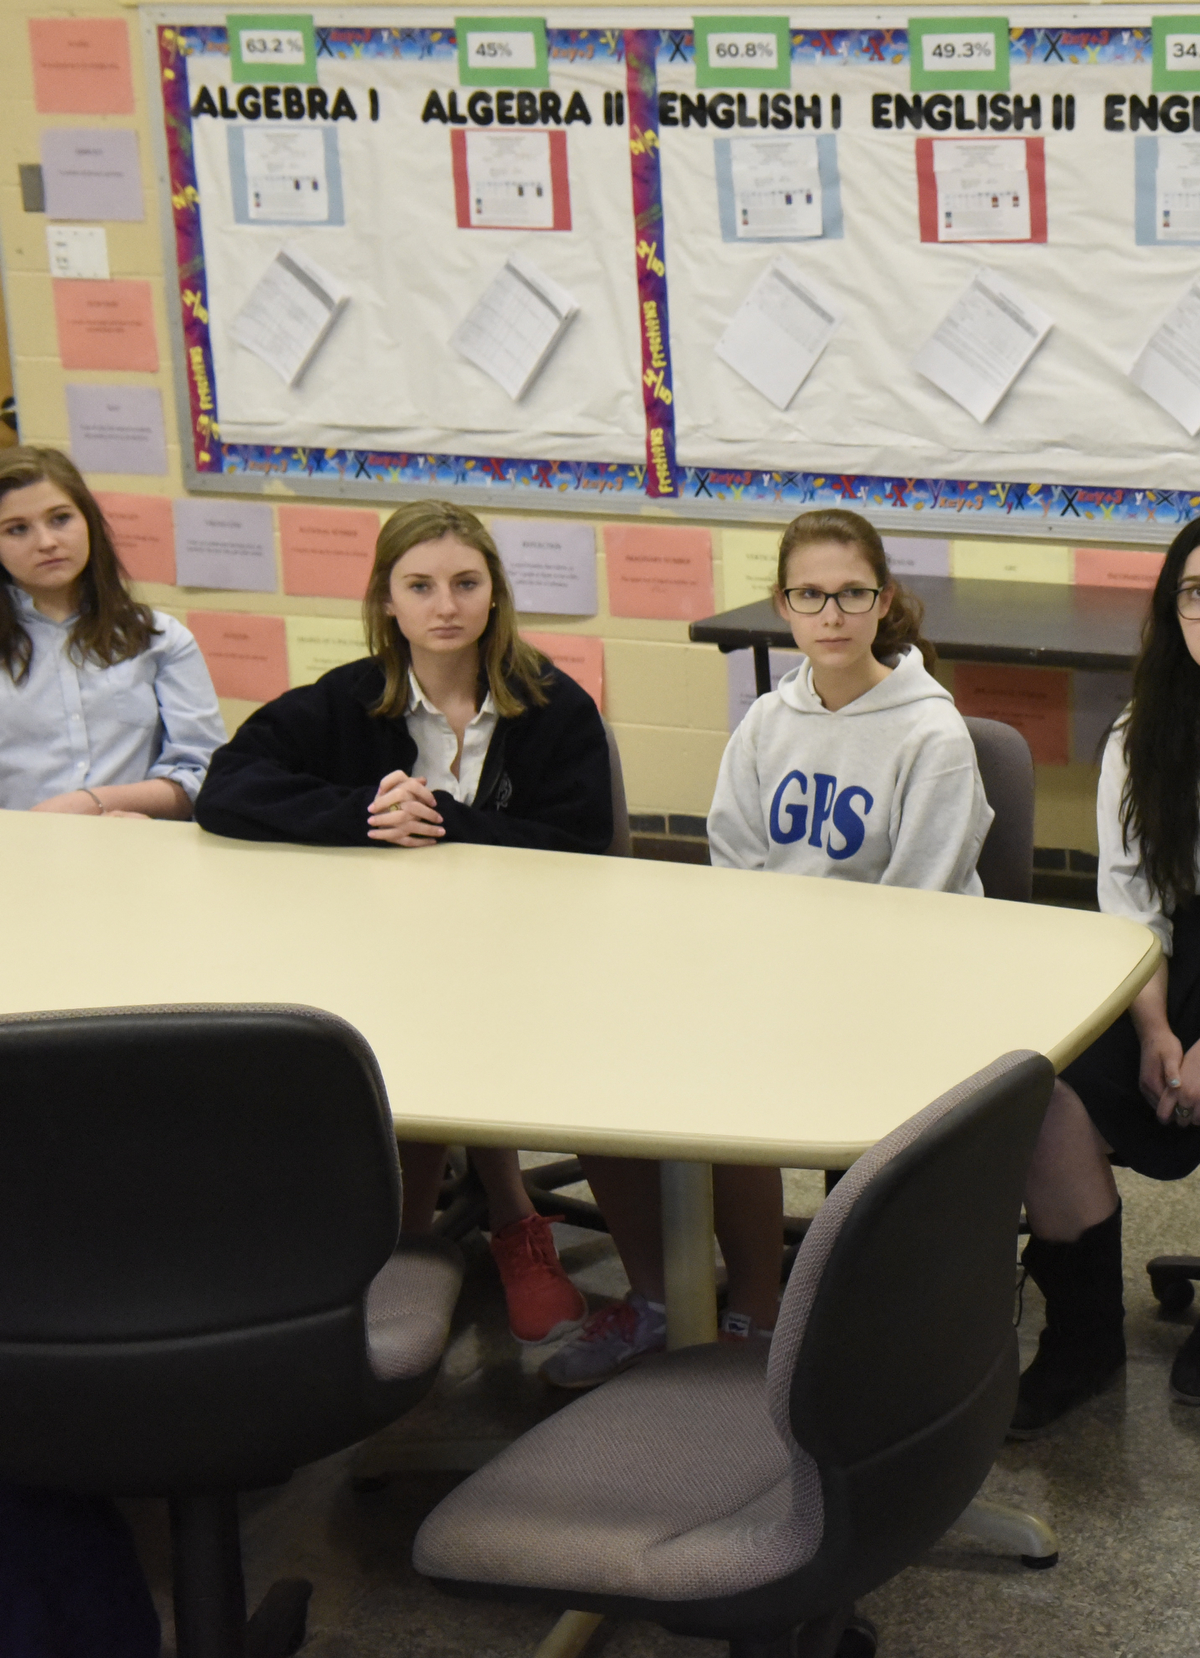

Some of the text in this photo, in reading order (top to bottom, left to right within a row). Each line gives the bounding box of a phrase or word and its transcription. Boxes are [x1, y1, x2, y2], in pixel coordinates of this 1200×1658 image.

[475, 42, 513, 57] 45%
[716, 43, 773, 58] 60.8%
[932, 43, 991, 59] 49.3%
[192, 85, 379, 121] ALGEBRA I
[421, 89, 624, 126] ALGEBRA II
[658, 92, 842, 129] ENGLISH I
[872, 93, 1075, 131] ENGLISH II
[769, 769, 874, 860] GPS
